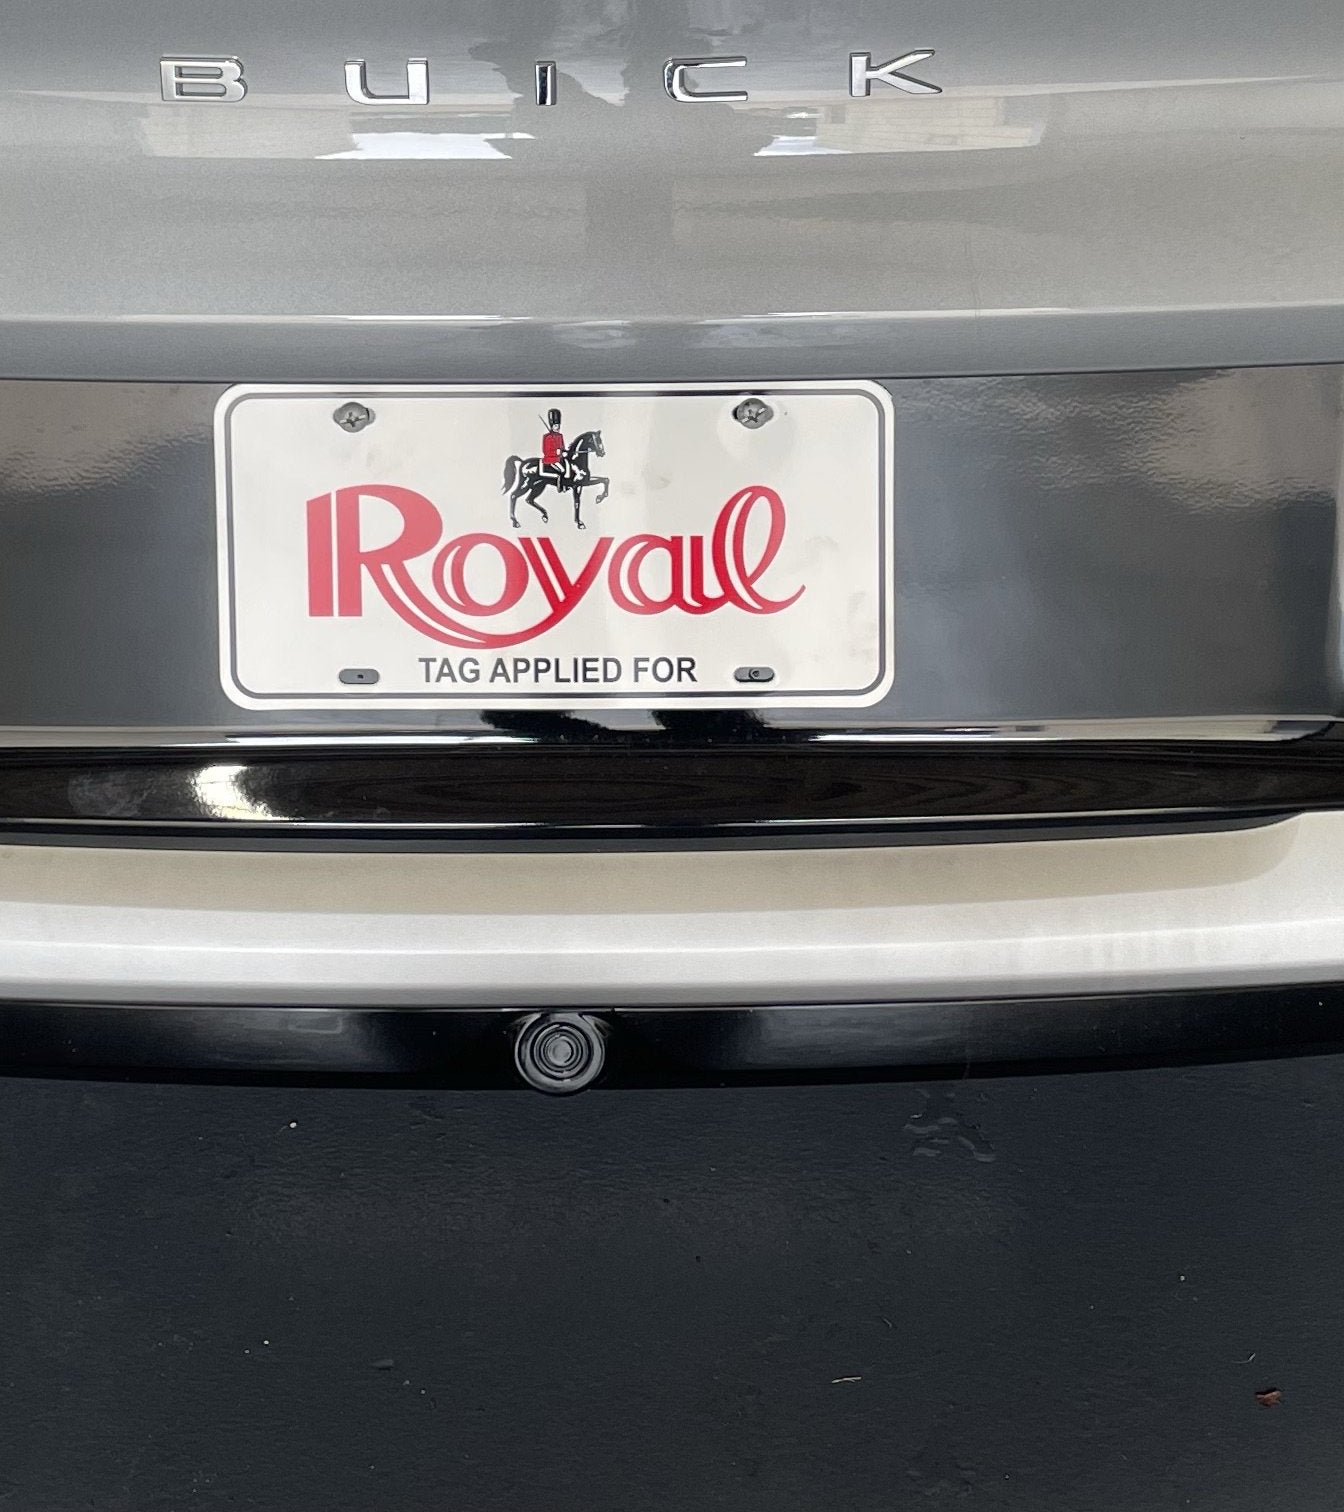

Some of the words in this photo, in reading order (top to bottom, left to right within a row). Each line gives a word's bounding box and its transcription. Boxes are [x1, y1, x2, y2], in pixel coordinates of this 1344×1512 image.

[159, 49, 944, 106] BUICK
[307, 484, 807, 650] Royal
[419, 656, 481, 684] TAG
[489, 656, 623, 684] APPLIED
[633, 656, 699, 684] FOR
